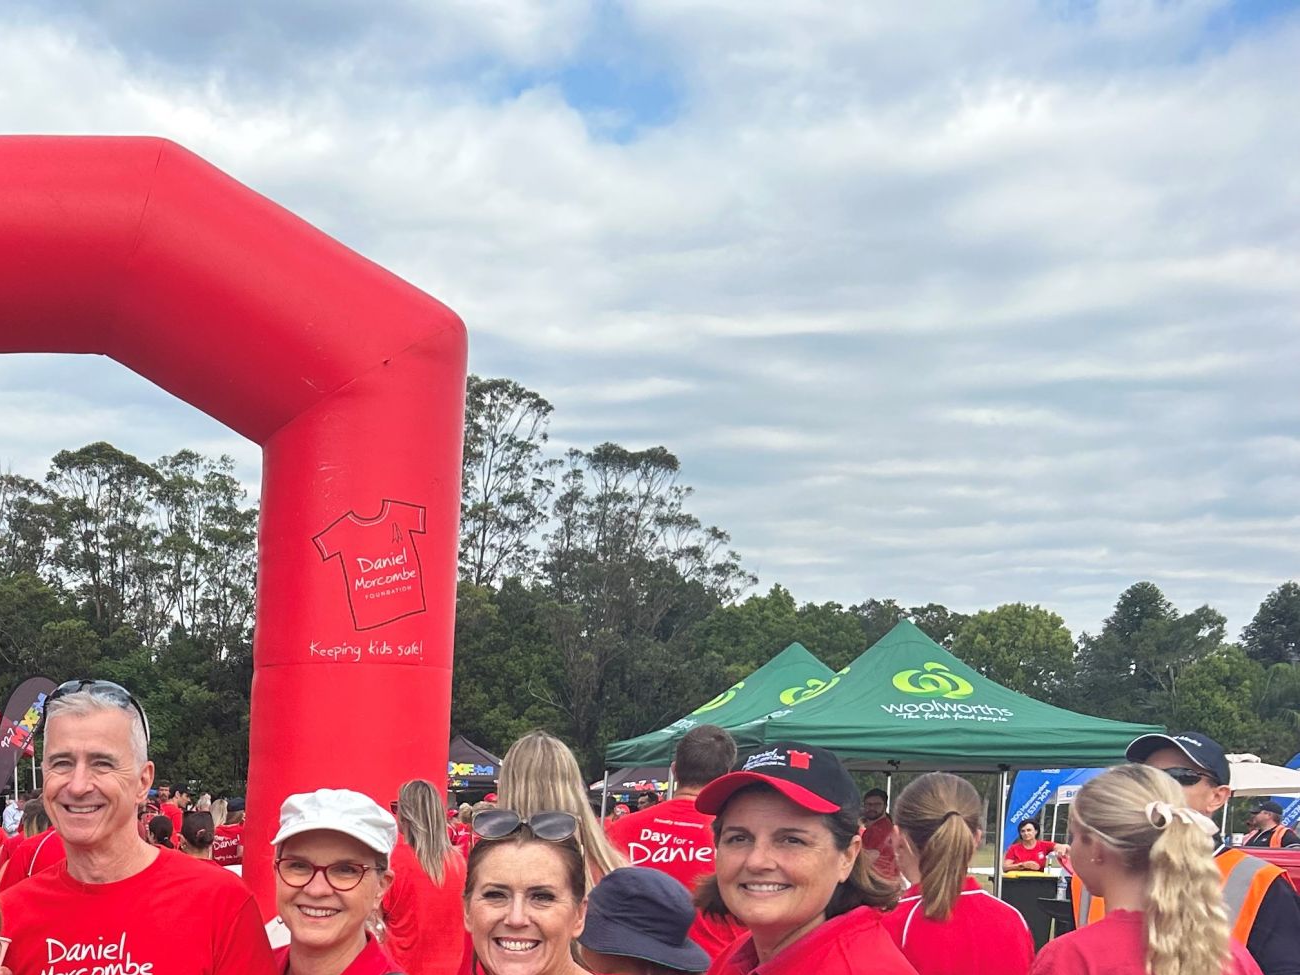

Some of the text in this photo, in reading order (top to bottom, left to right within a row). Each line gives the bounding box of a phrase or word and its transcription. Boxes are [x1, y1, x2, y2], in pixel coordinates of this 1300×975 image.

[357, 547, 408, 573] Daniel
[355, 568, 416, 591] Morcombe
[365, 585, 412, 600] FOUNDATION
[309, 640, 423, 662] Keeping kids safe!
[881, 700, 1013, 717] woolworths
[923, 712, 950, 720] fresh
[954, 712, 975, 720] food
[640, 828, 686, 845] Day for
[46, 931, 126, 964] Daniel
